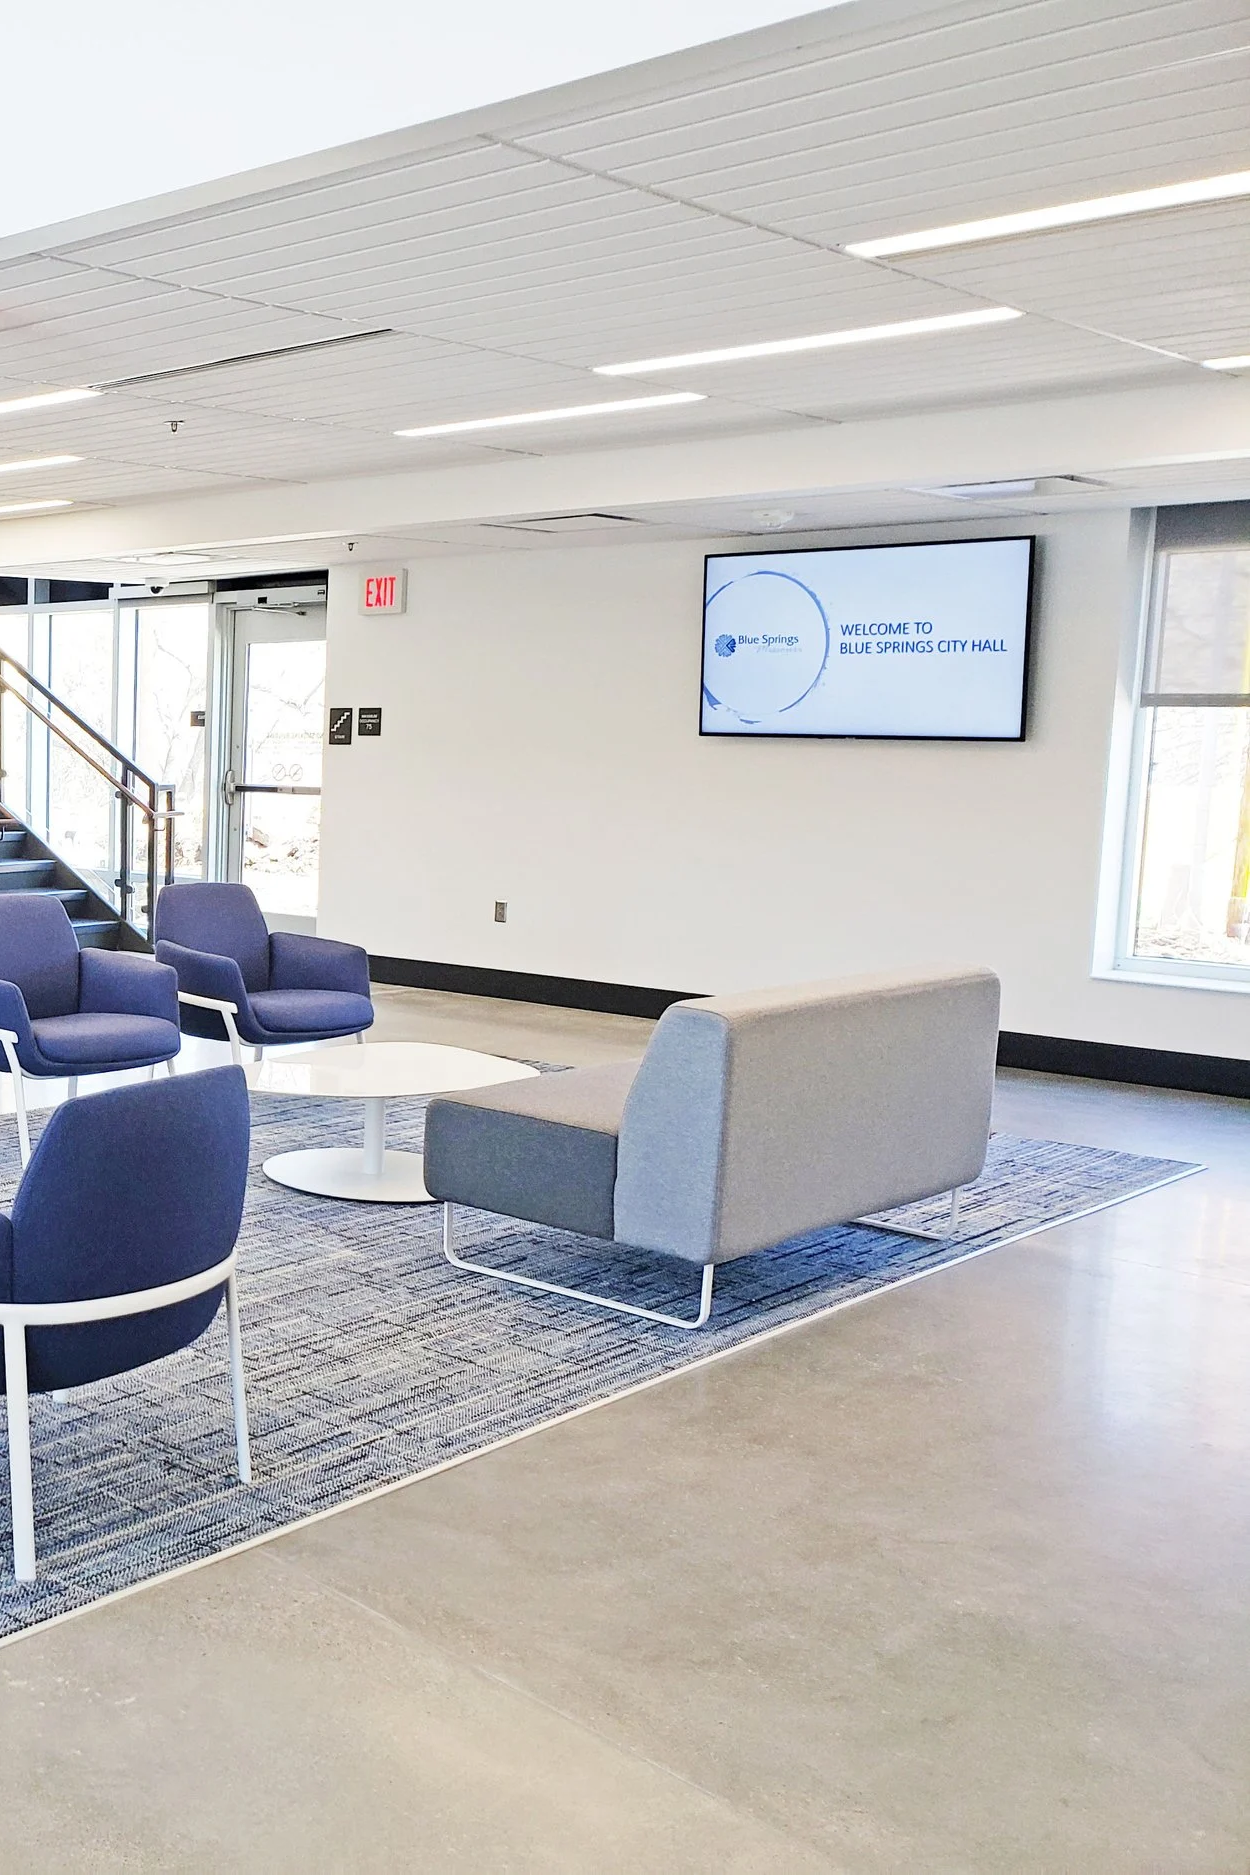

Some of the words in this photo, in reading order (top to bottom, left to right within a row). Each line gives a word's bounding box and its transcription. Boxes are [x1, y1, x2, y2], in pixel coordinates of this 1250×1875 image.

[365, 577, 396, 607] EXIT
[840, 622, 910, 637] WELCOME
[913, 621, 933, 635] TO
[738, 635, 760, 645] Blue
[761, 634, 799, 647] Springs
[839, 641, 873, 655] BLUE
[876, 640, 934, 654] SPRINGS
[937, 640, 969, 653] CITY
[972, 639, 1008, 653] HALL
